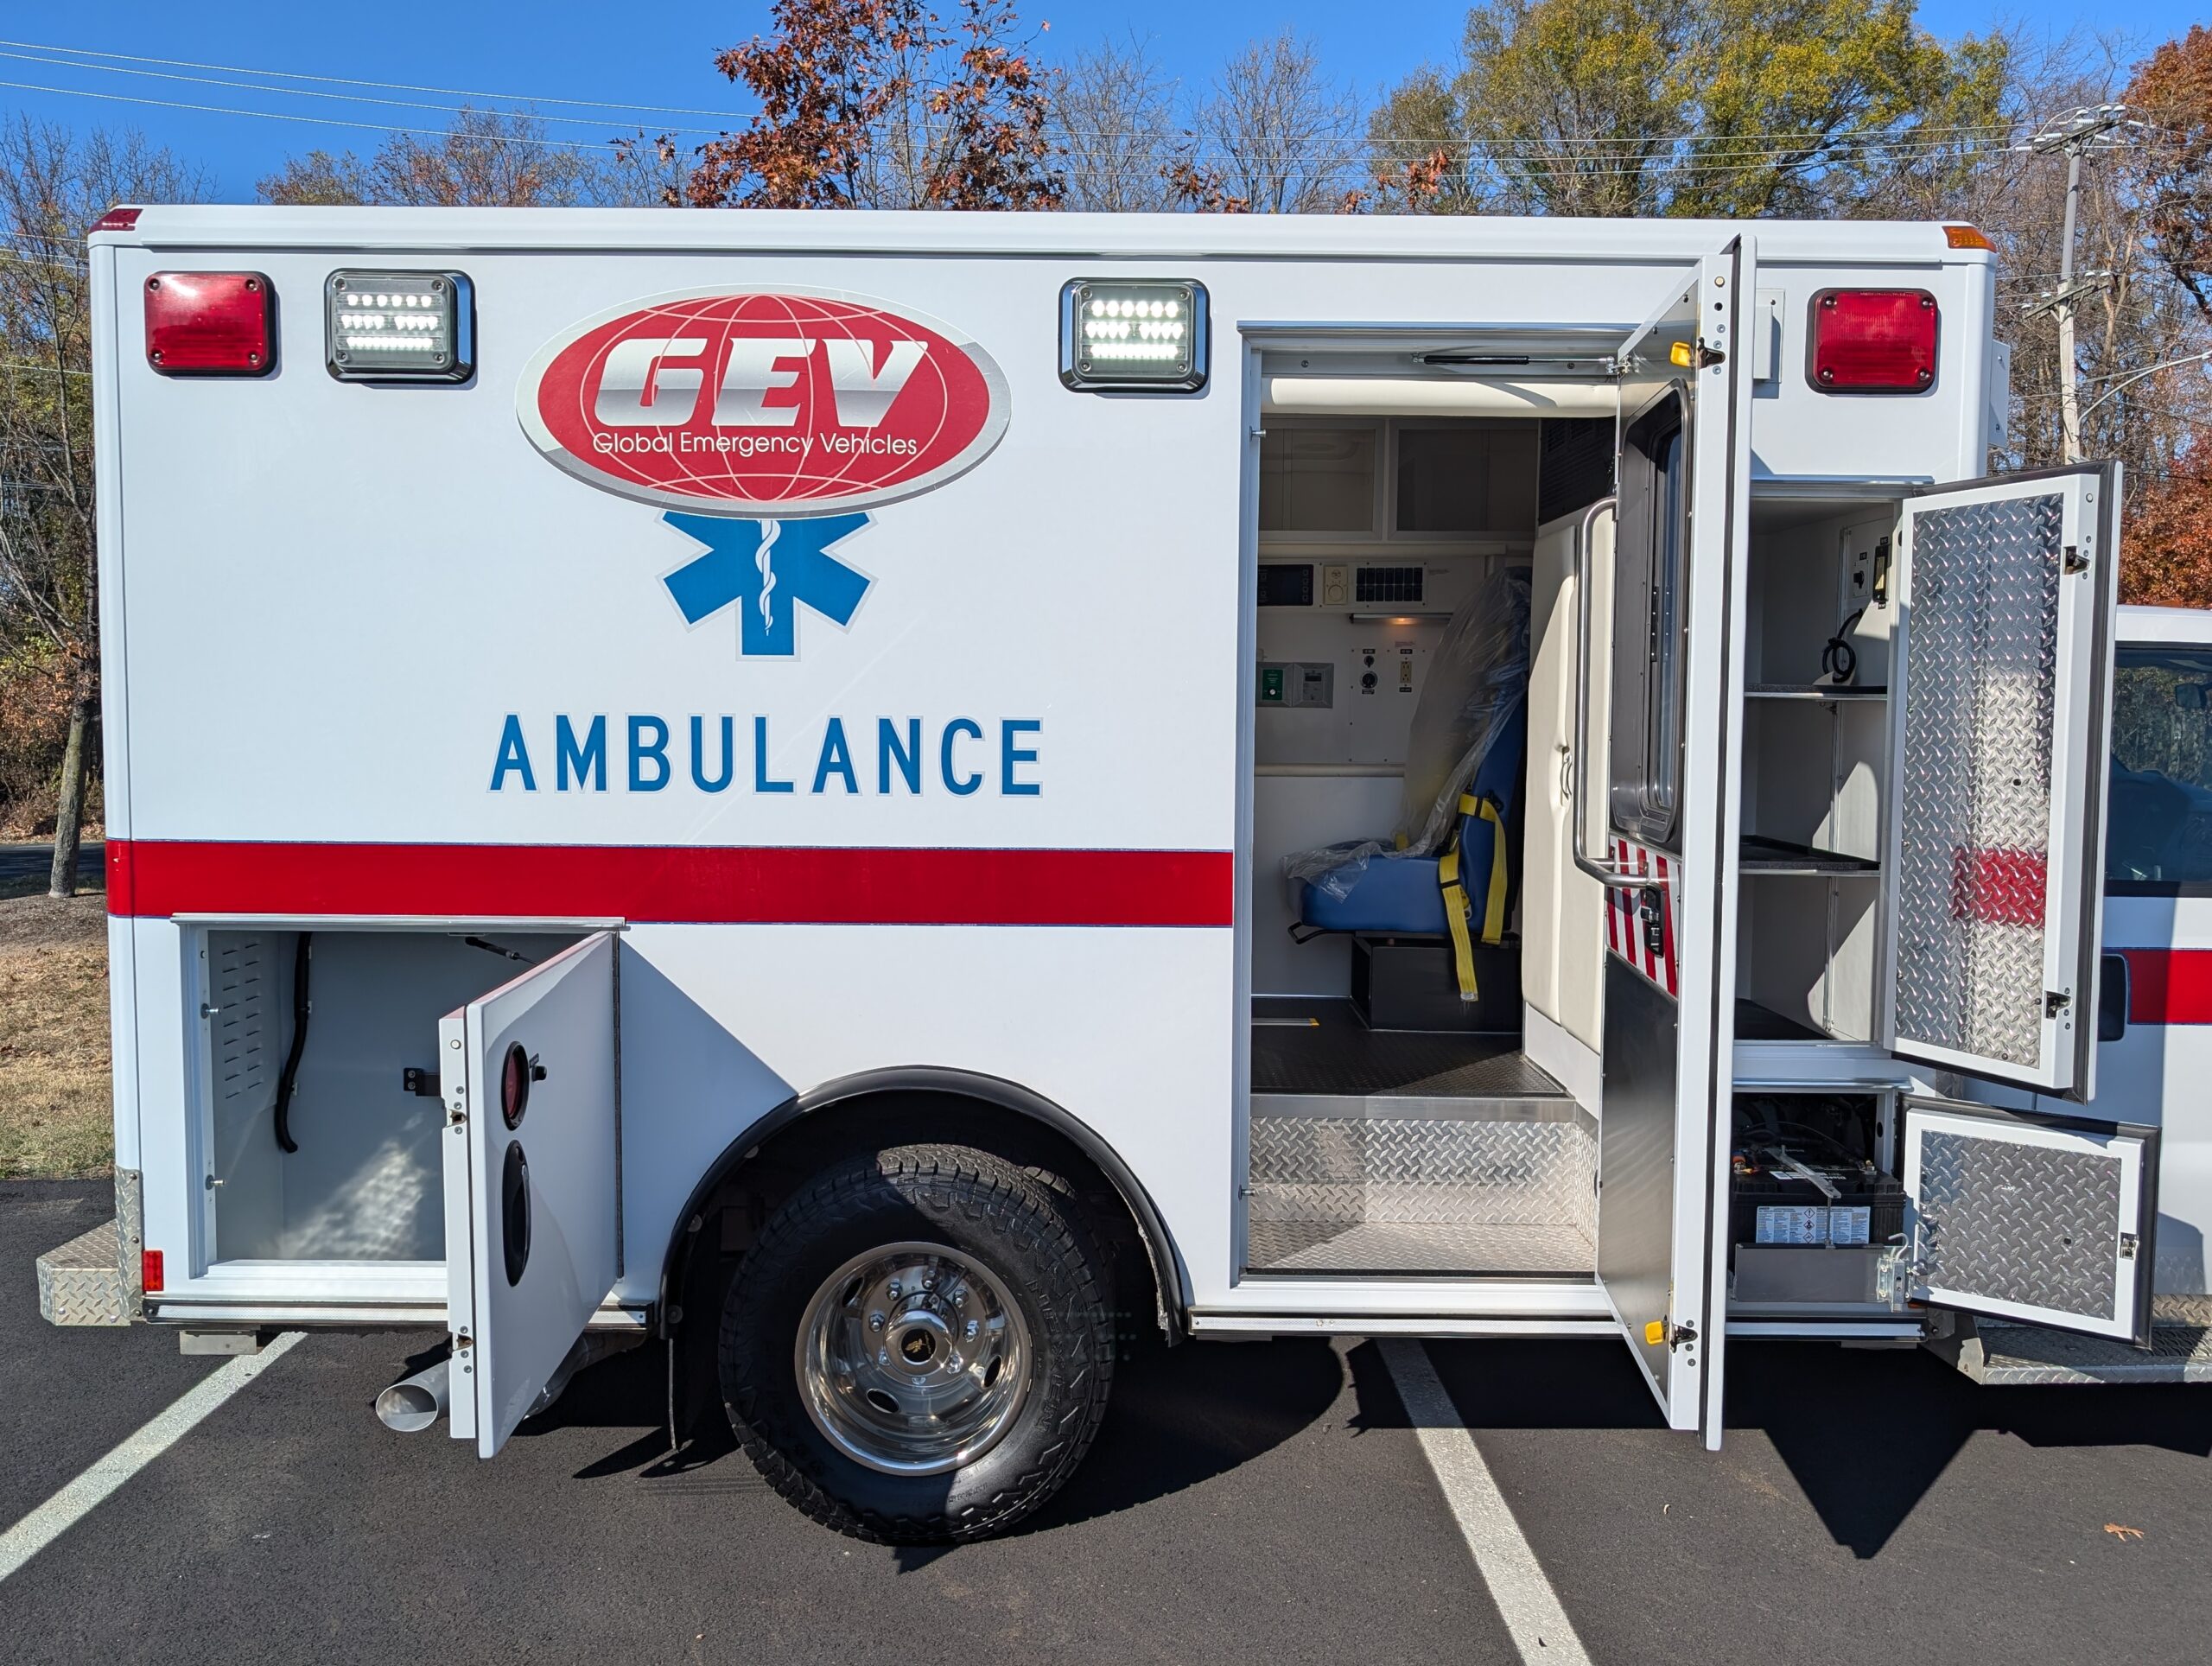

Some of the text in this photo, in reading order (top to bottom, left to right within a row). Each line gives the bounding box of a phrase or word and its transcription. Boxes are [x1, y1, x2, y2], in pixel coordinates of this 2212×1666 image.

[594, 338, 929, 428] GEV
[593, 432, 917, 458] Global Emergency Vehicles
[489, 713, 1042, 797] AMBULANCE
